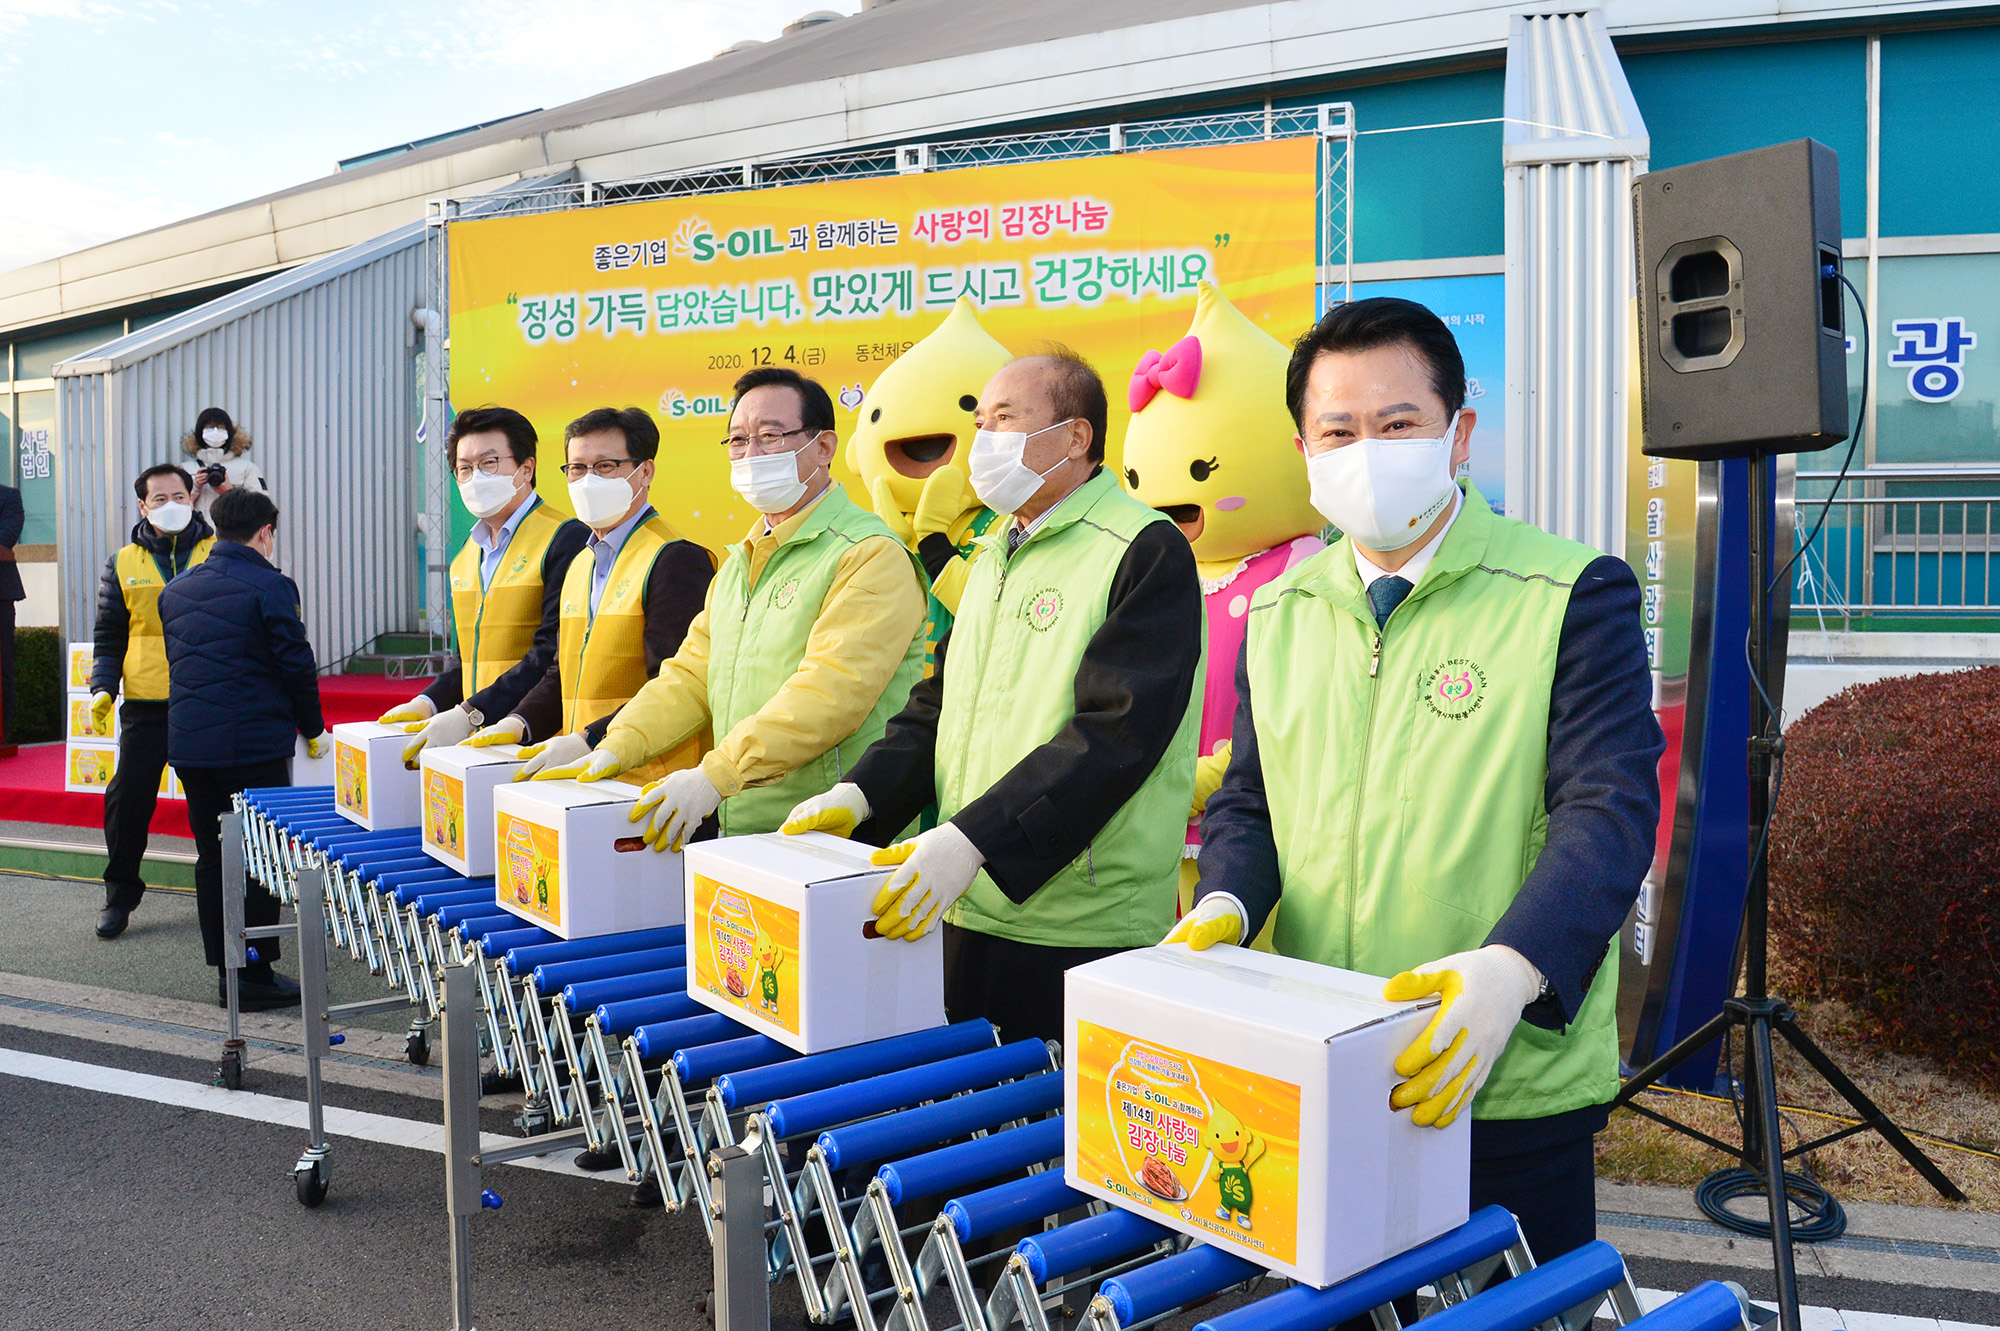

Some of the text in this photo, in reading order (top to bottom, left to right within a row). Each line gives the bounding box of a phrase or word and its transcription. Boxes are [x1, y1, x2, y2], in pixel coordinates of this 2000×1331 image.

[595, 239, 666, 269] 좋은기업
[693, 228, 784, 261] S-OIL
[816, 219, 898, 249] 함께하는
[914, 208, 989, 243] 사랑의
[1002, 201, 1109, 237] 김장나눔
[588, 293, 647, 333] 가득
[656, 284, 801, 328] 담았습니다.
[813, 270, 913, 317] 맛있게
[925, 268, 1021, 305] 드시고
[708, 355, 744, 369] 2020.
[752, 346, 776, 366] 12.
[672, 398, 726, 416] S-OIL
[22, 429, 49, 452] 사단
[22, 453, 49, 477] 법인
[1447, 658, 1470, 666] BEST
[1470, 662, 1488, 688] ULSAN
[1115, 1080, 1138, 1096] 좋은기업
[1144, 1090, 1171, 1107] S-OIL
[1179, 1103, 1204, 1118] 함께하는
[1122, 1100, 1197, 1146] 제14회 사랑의
[1106, 1179, 1132, 1197] S-OIL
[1232, 1185, 1246, 1202] S
